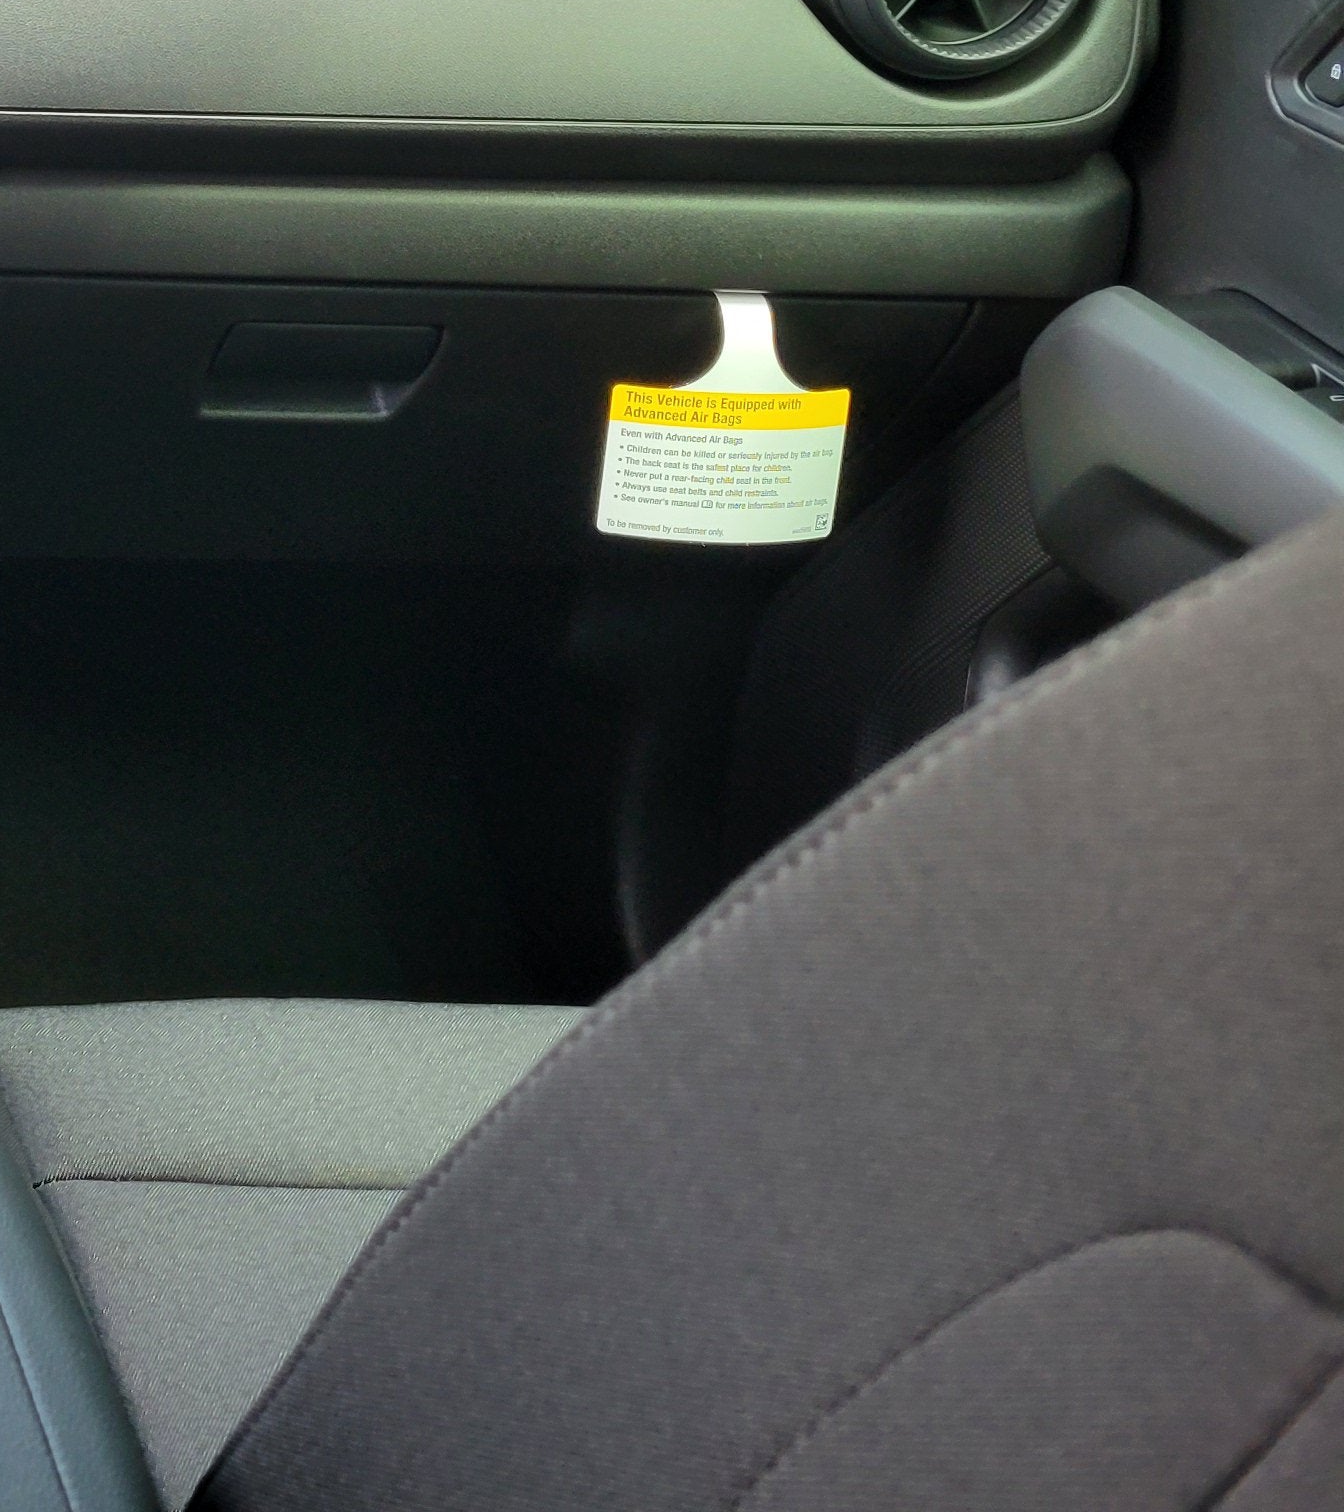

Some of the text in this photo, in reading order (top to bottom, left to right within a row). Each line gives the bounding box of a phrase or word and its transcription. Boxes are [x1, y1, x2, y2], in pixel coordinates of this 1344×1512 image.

[626, 391, 801, 412] This Vehicle is Equipped with
[624, 406, 742, 426] Advanced Air Bags
[621, 428, 743, 445] Even with Advanced Air Bags
[626, 444, 662, 455] Children
[664, 449, 679, 457] can
[681, 449, 691, 457] be
[694, 450, 715, 459] killed
[764, 451, 788, 460] injured
[625, 457, 640, 465] The
[642, 458, 661, 468] back
[664, 461, 680, 469] seat
[682, 462, 689, 470] is
[692, 463, 703, 471] the
[624, 469, 647, 478] Never
[649, 473, 662, 481] put
[672, 475, 714, 485] rear-facing
[622, 481, 650, 492] Always
[688, 487, 707, 496] belts
[621, 493, 635, 502] See
[638, 497, 668, 506] owner's
[672, 499, 699, 508] manual
[607, 518, 615, 527] To
[617, 519, 626, 528] be
[628, 522, 660, 532] removed
[662, 524, 671, 534] by
